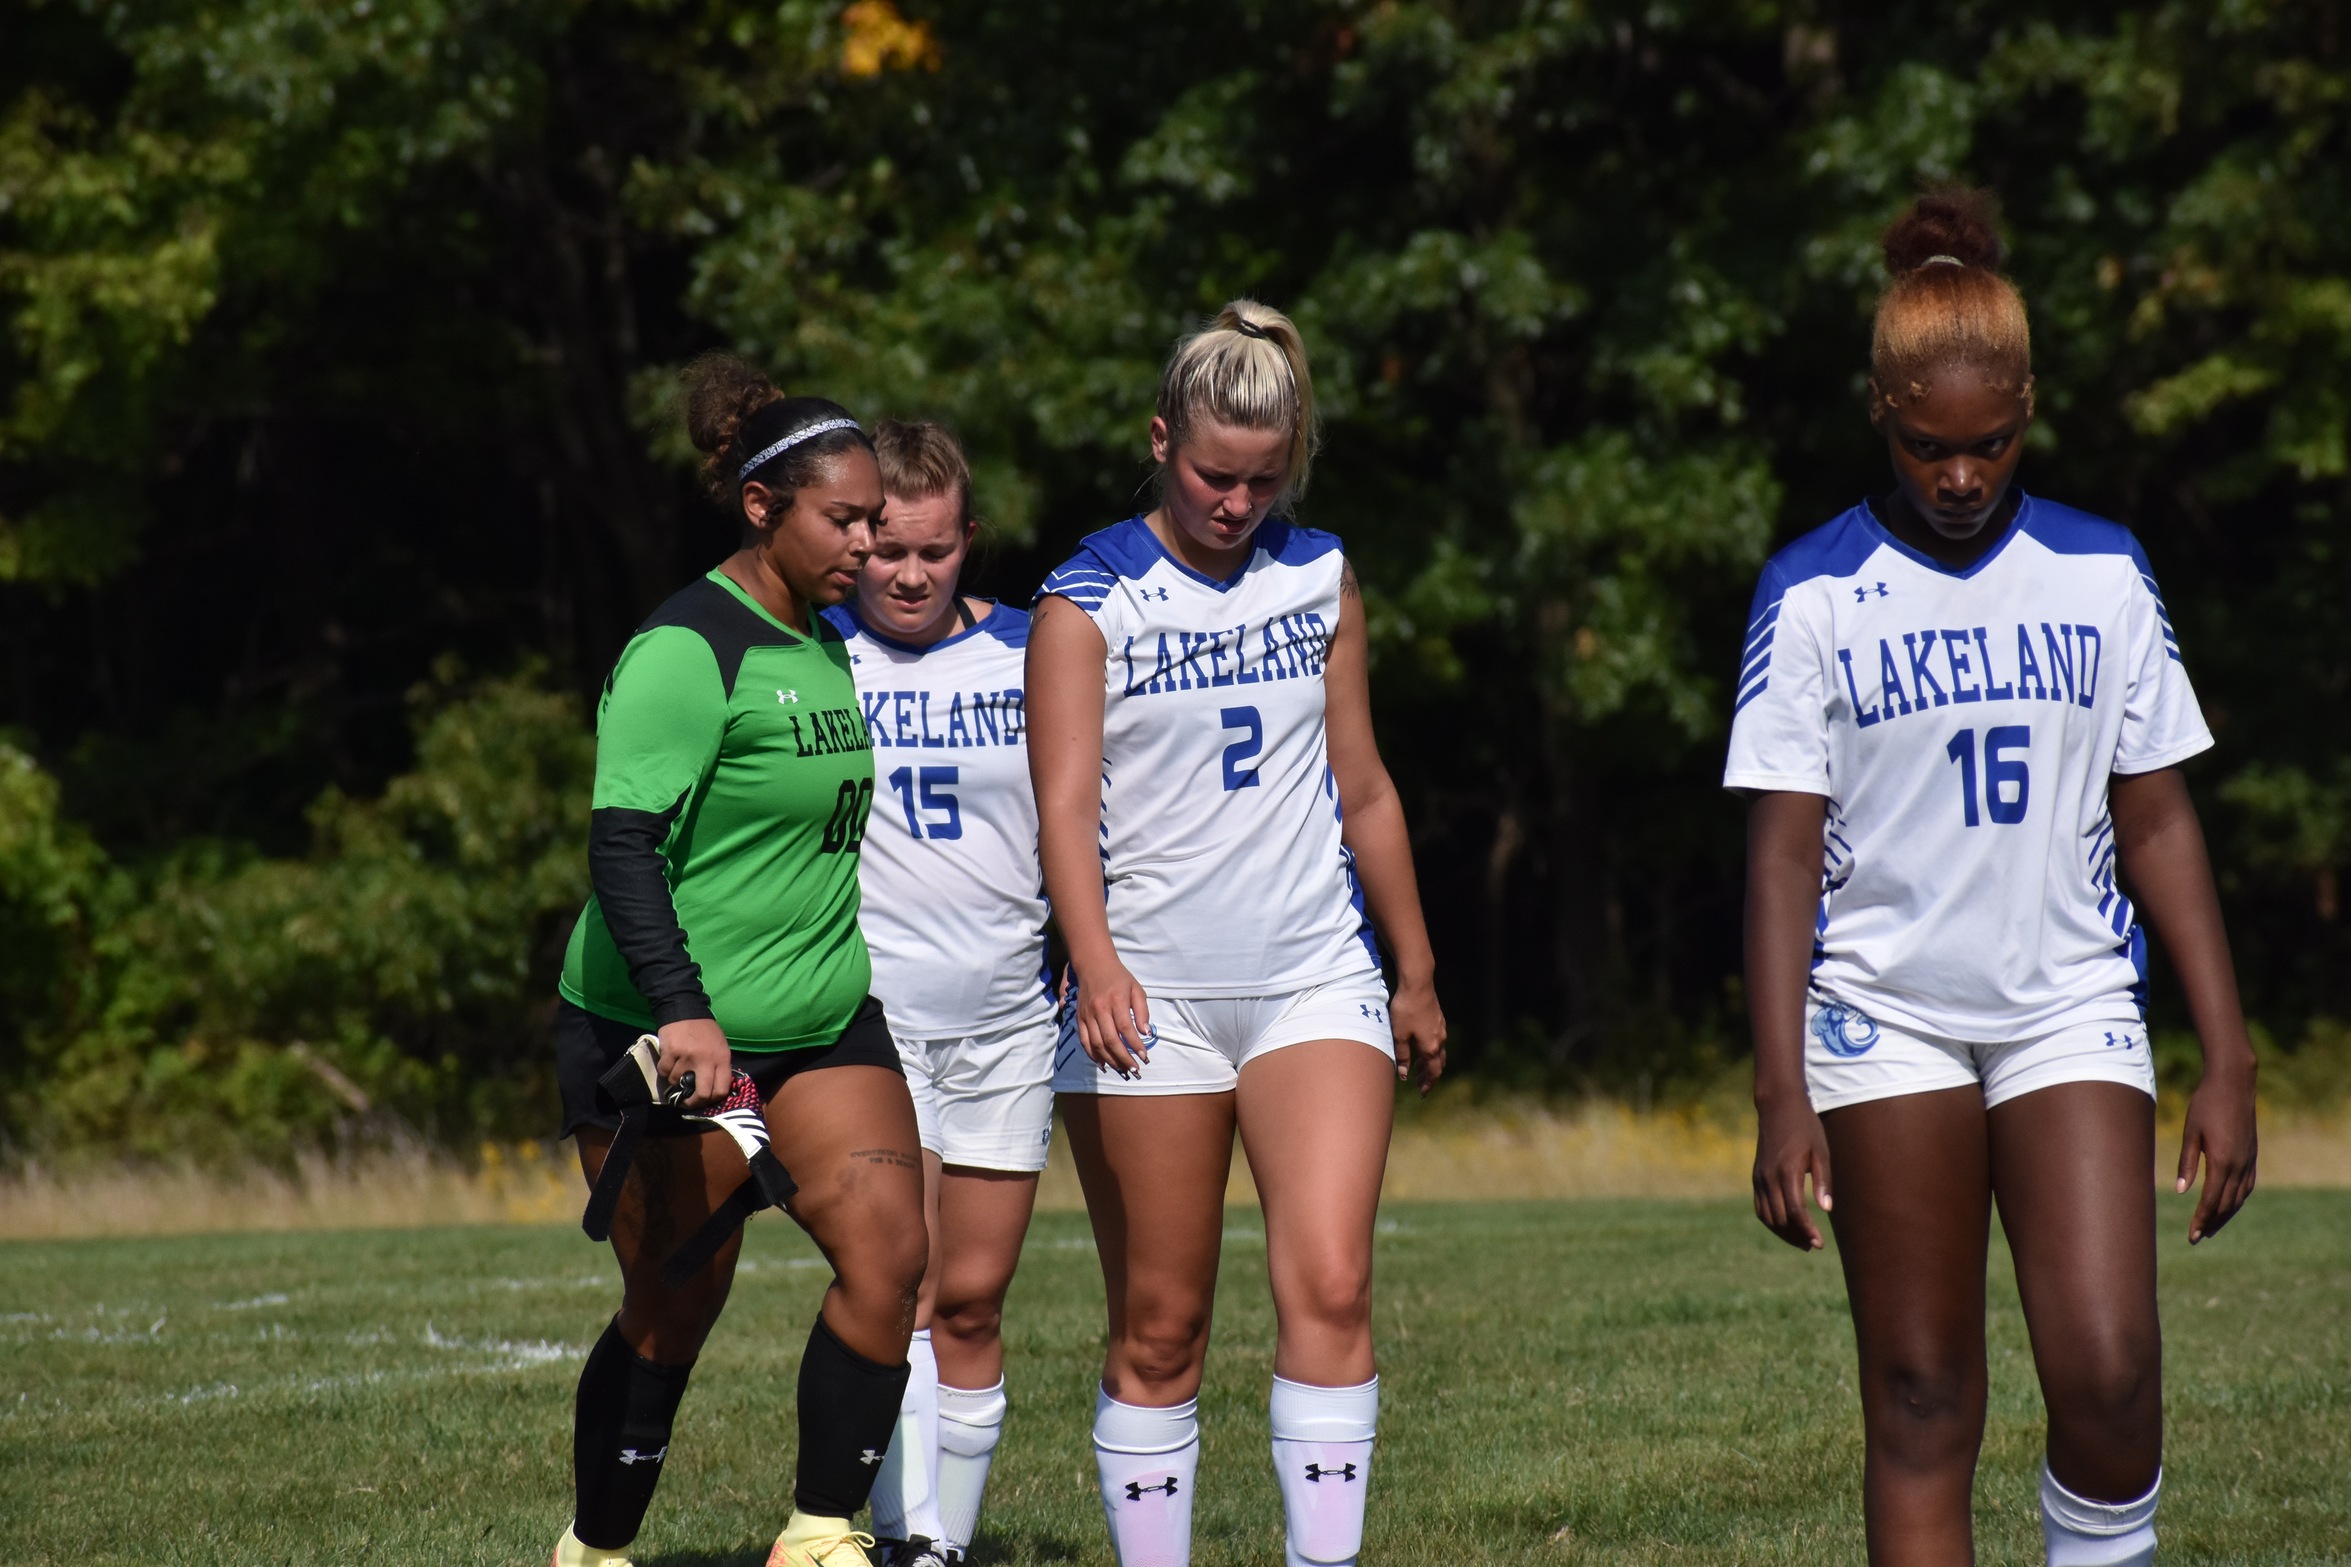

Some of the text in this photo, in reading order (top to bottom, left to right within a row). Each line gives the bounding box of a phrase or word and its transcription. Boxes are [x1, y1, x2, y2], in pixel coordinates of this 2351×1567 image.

[1123, 613, 1327, 698] LAKELAND
[1837, 622, 2102, 729] LAKELAND
[788, 706, 873, 758] LAKELA
[862, 688, 1025, 748] KELAND
[1219, 705, 1263, 792] 2
[821, 777, 874, 854] 00
[888, 766, 963, 841] 15
[1946, 725, 2031, 828] 16
